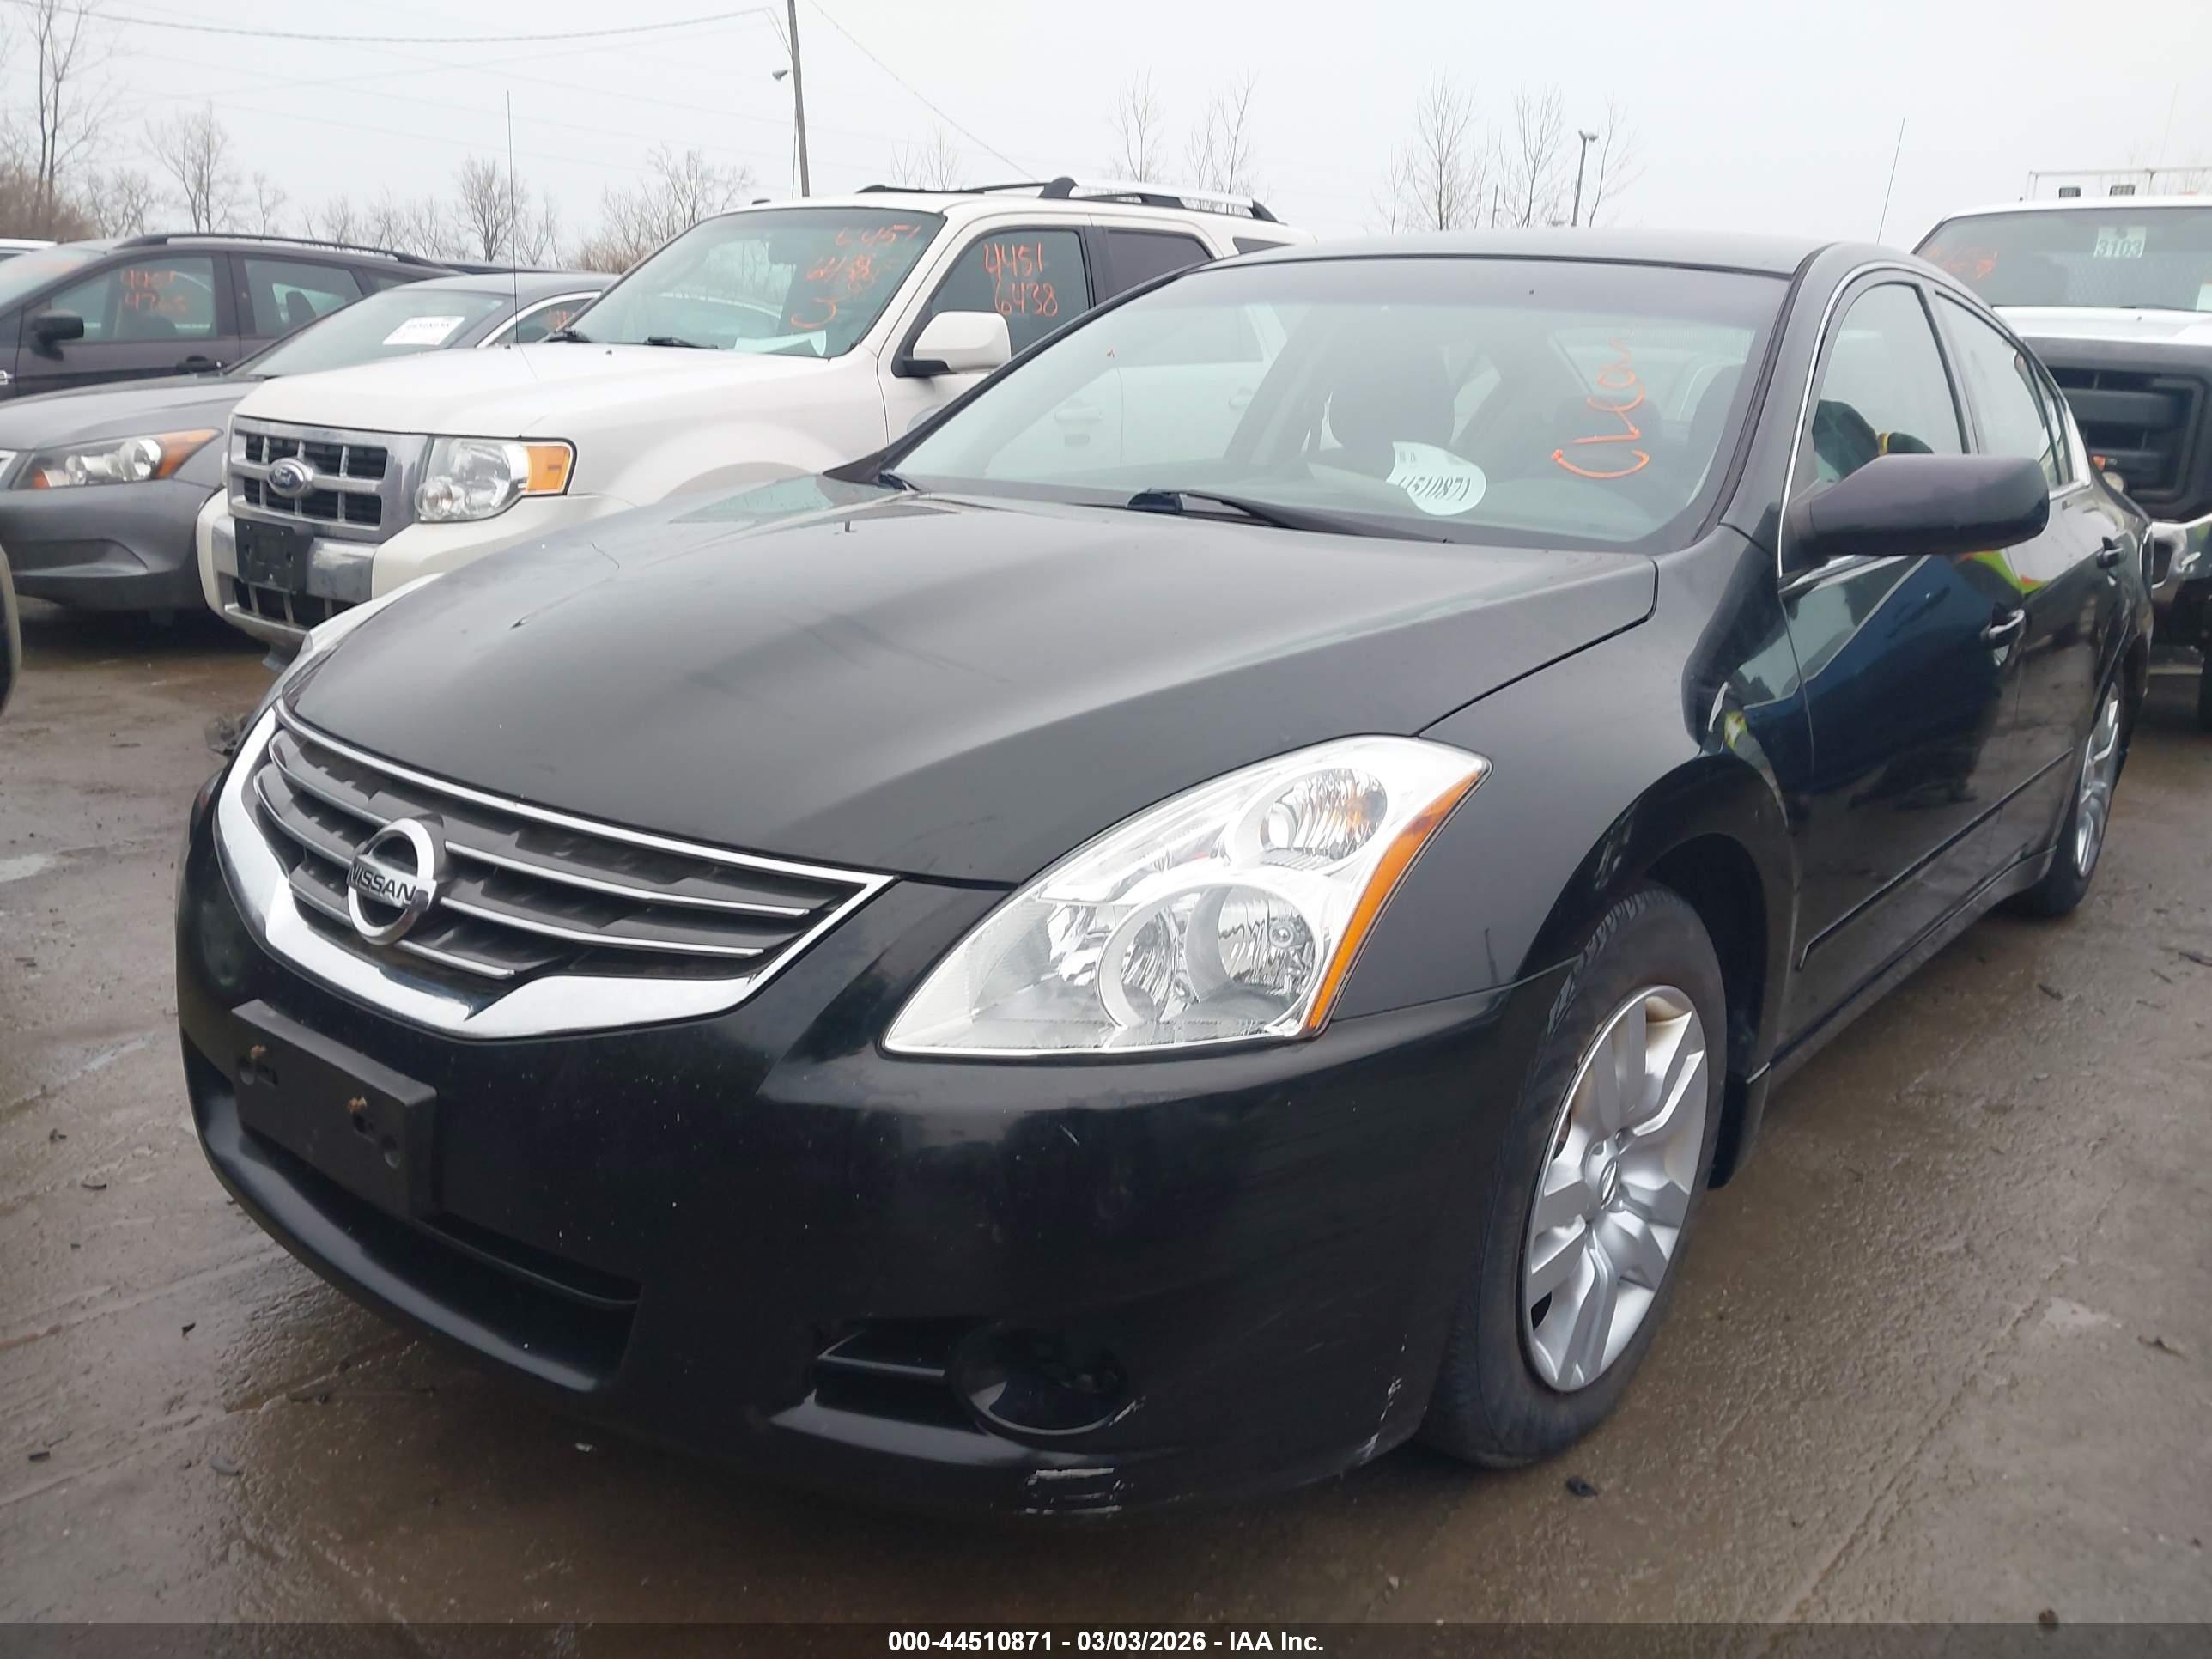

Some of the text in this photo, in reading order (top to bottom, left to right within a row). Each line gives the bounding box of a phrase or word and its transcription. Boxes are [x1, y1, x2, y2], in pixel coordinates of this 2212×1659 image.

[983, 242, 1043, 276] 4451
[994, 280, 1058, 316] 6438
[349, 865, 417, 902] NISSAN
